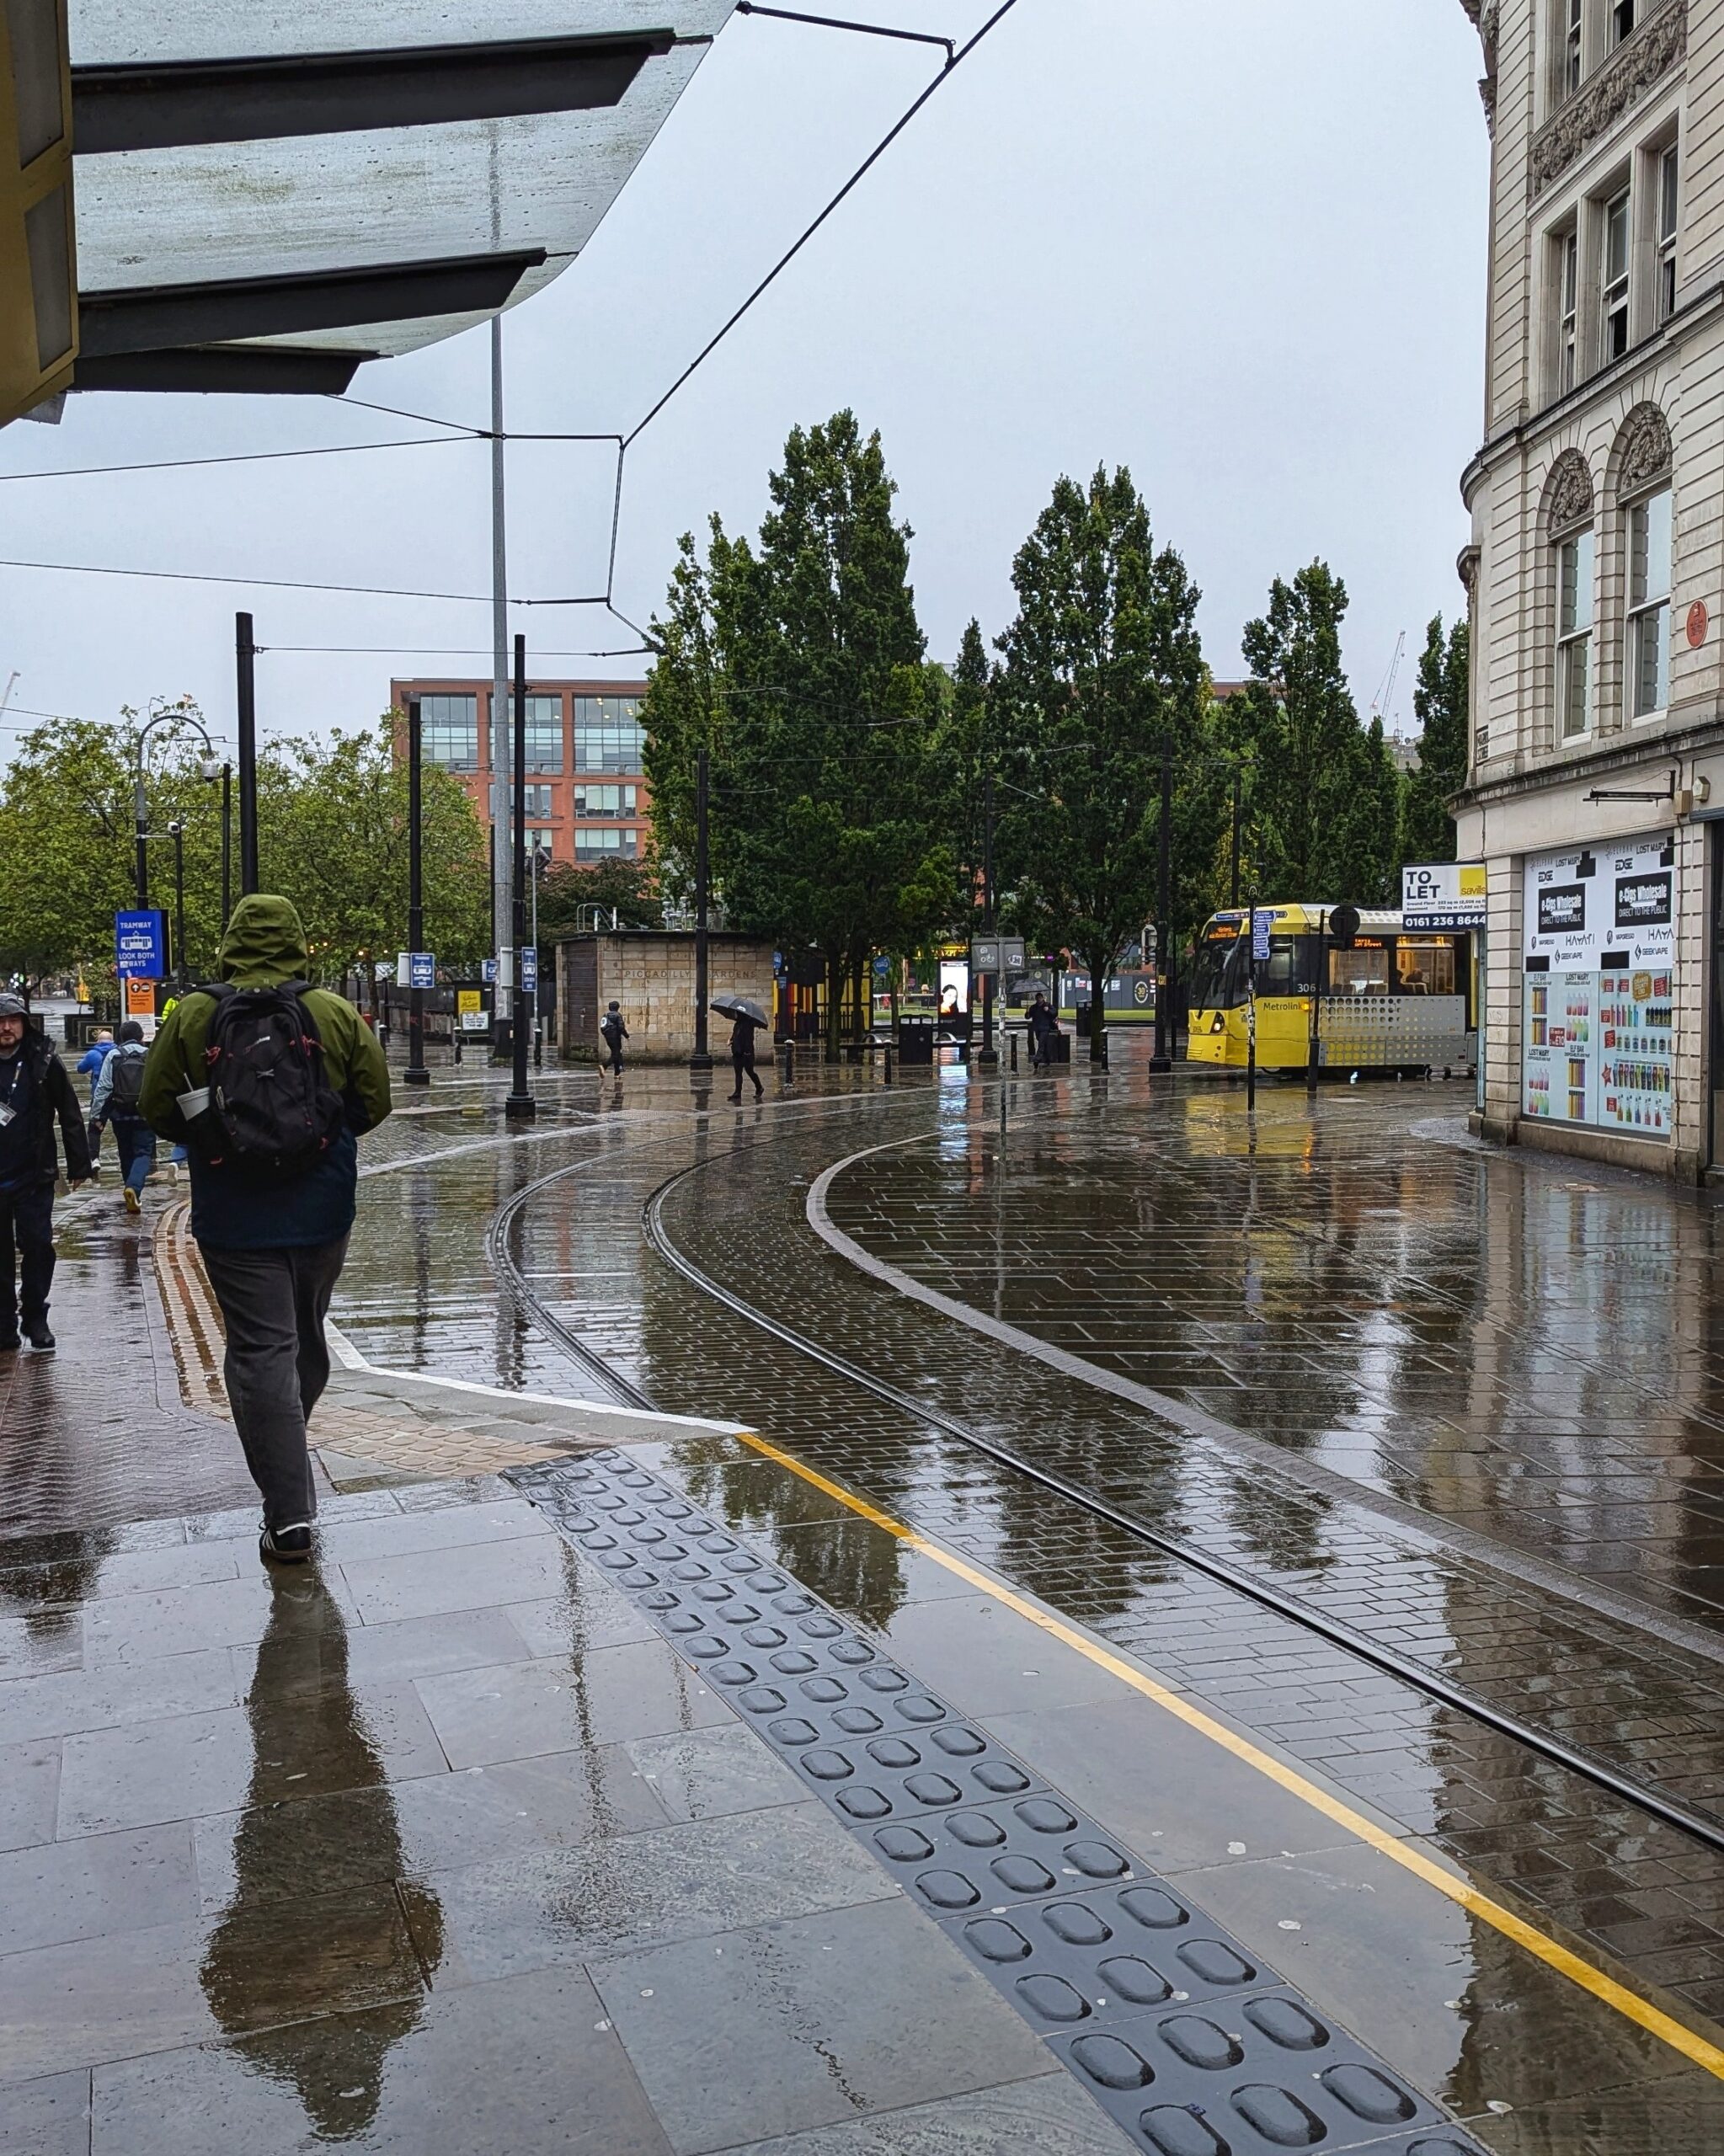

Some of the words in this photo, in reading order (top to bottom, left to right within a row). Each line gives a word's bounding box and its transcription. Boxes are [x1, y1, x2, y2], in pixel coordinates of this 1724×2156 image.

[1636, 845, 1650, 855] LOST
[1556, 858, 1567, 867] LOST
[1406, 870, 1432, 884] TO
[1406, 884, 1441, 899] LET
[1637, 883, 1667, 901] Wholesale
[1556, 894, 1582, 910] Wholesale
[1619, 908, 1634, 917] DIRECT
[1635, 907, 1641, 916] TO
[1641, 906, 1650, 915] THE
[1651, 904, 1668, 915] PUBLIC
[1405, 917, 1430, 927] 0161
[1432, 916, 1454, 926] 236
[1456, 915, 1486, 926] 8644
[1541, 916, 1554, 925] DIRECT
[1567, 913, 1582, 922] PUBLIC
[1642, 947, 1668, 955] GEEKVAPE
[624, 969, 691, 978] PICCADILLY
[1297, 983, 1321, 993] 306
[1263, 1002, 1303, 1011] Metrolink
